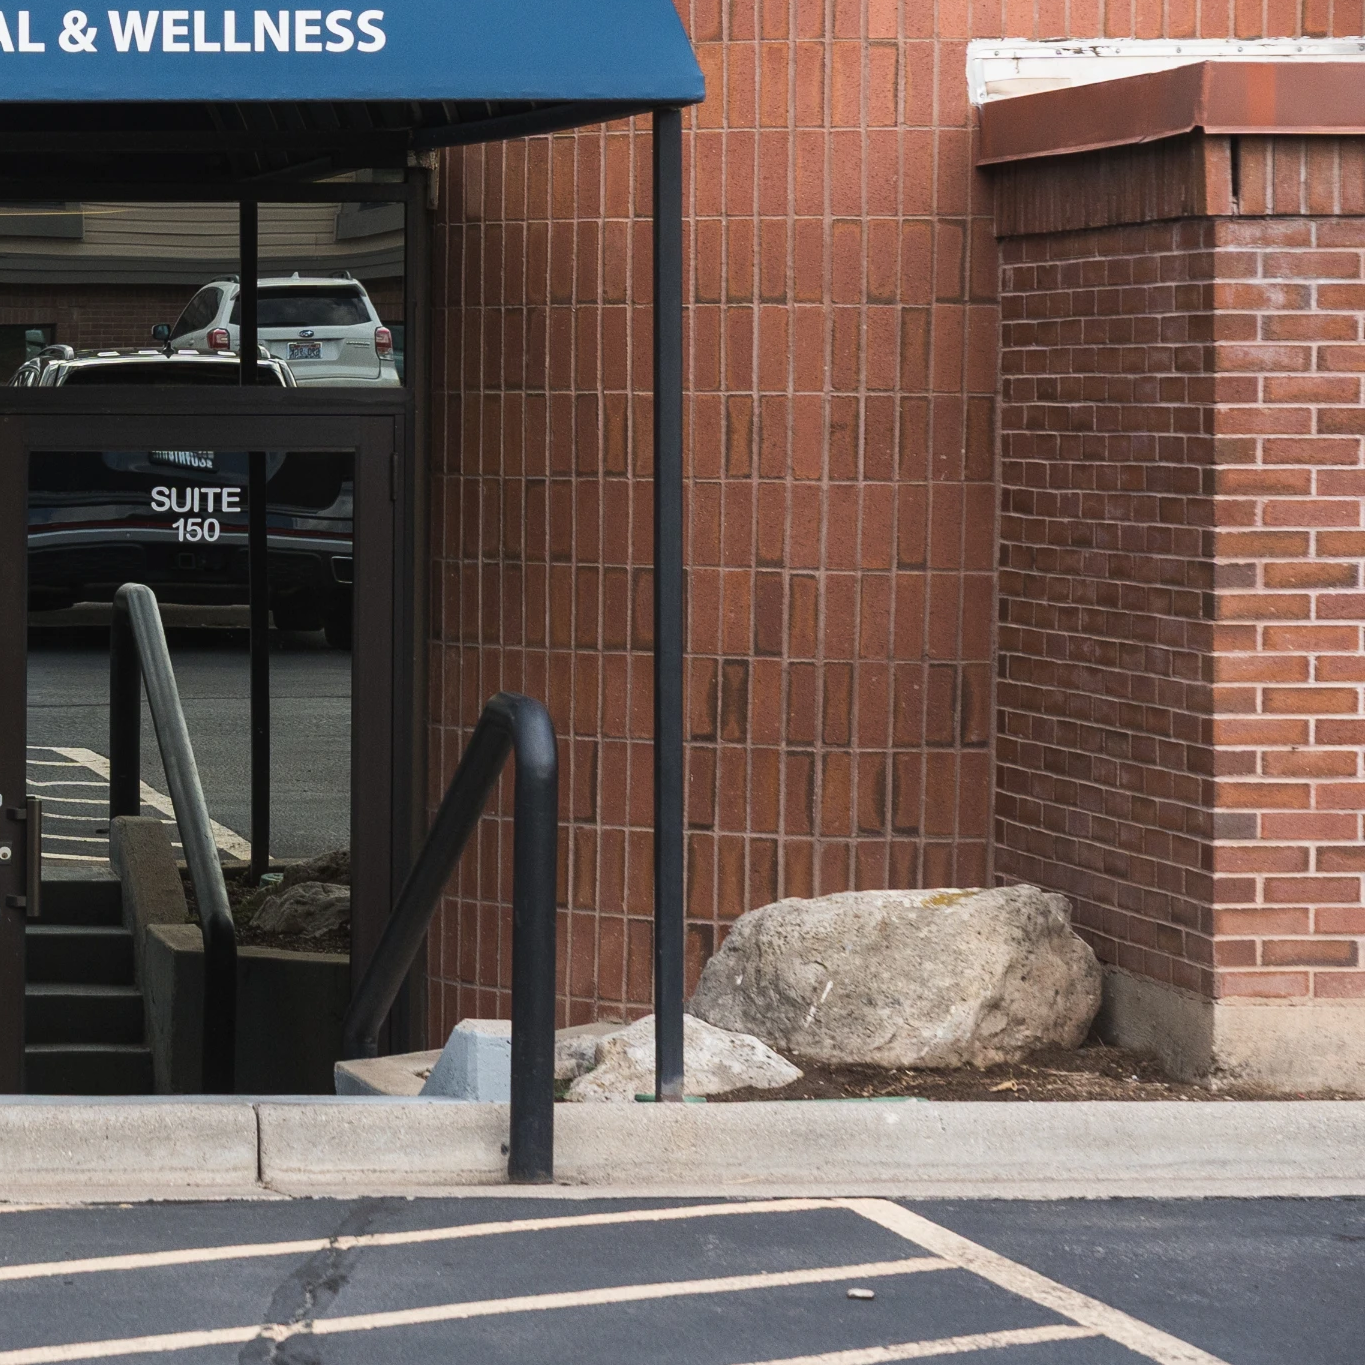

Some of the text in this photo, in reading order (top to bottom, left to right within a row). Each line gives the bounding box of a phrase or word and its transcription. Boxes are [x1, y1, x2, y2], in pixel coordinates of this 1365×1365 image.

[58, 9, 98, 52] &
[107, 9, 387, 52] WELLNESS
[150, 486, 241, 513] SUITE
[172, 517, 220, 542] 150
